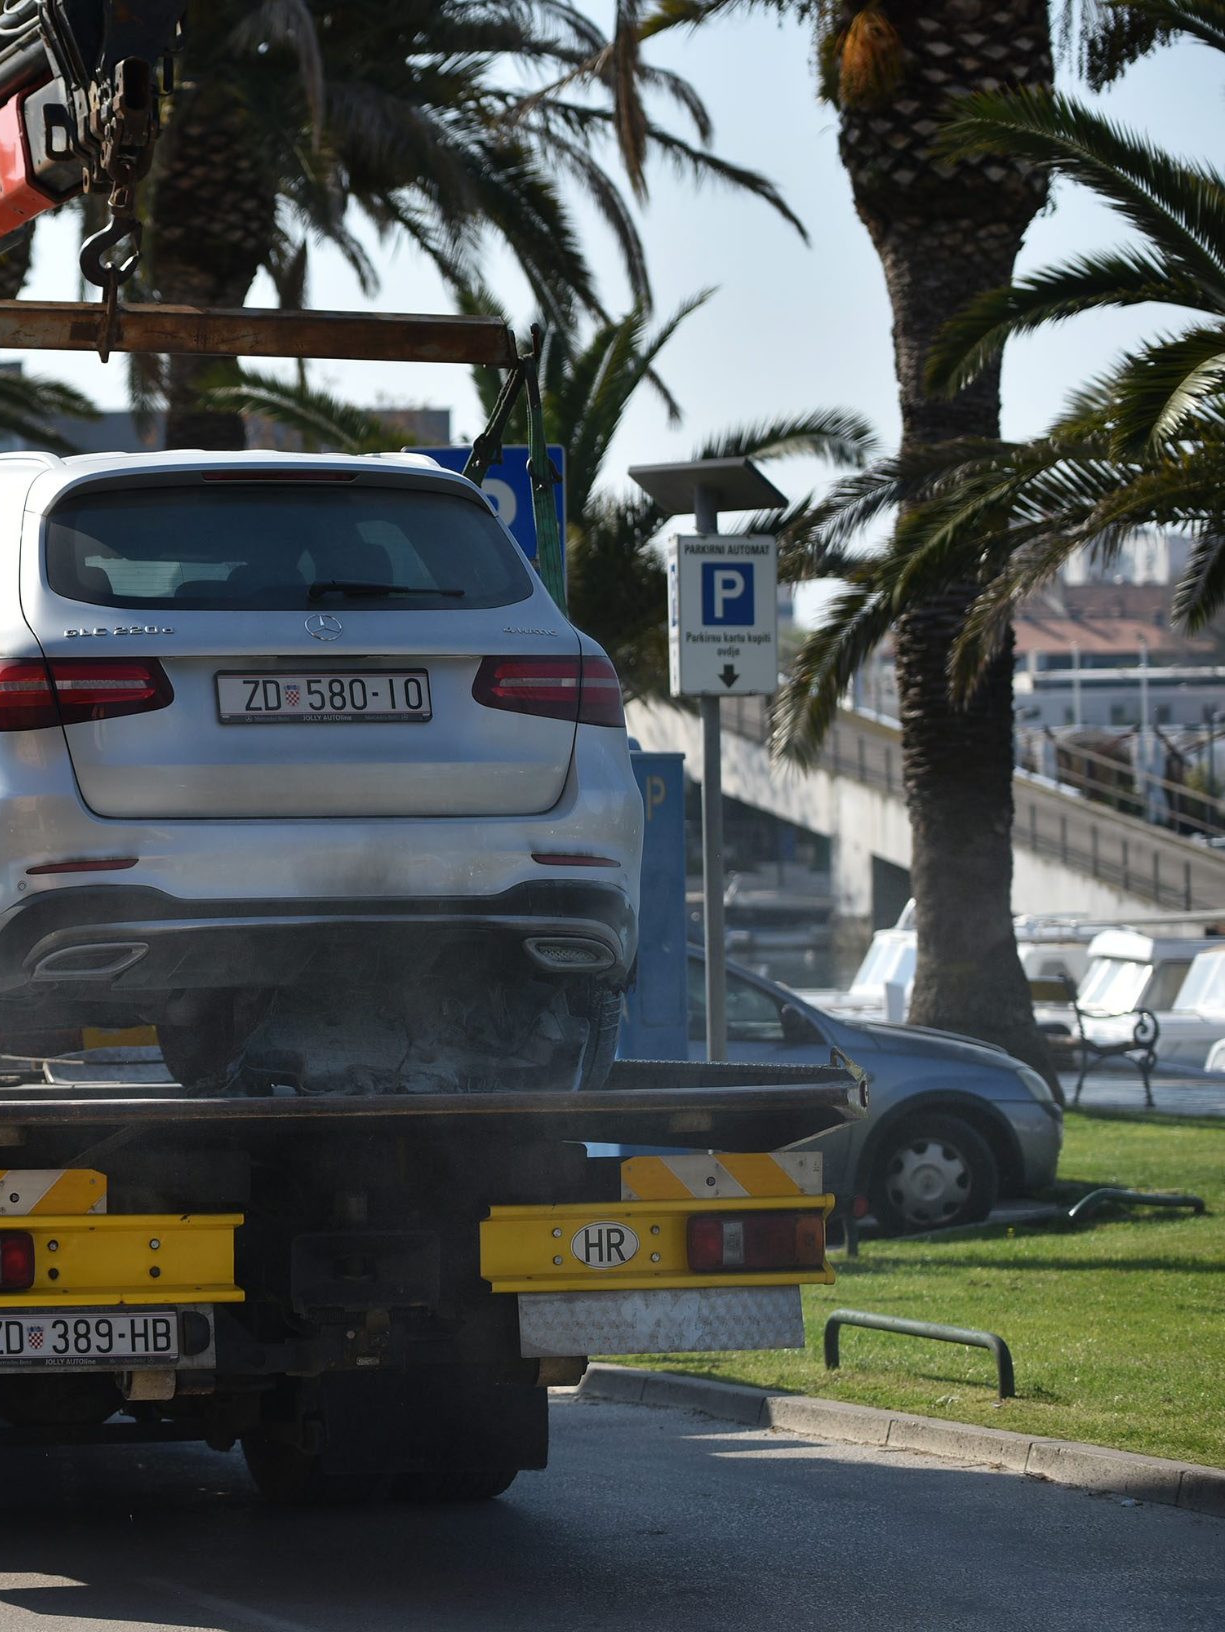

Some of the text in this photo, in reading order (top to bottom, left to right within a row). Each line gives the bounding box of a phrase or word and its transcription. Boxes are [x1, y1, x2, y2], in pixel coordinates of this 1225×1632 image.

[684, 544, 770, 555] PARKIRNI AUTOMAT
[714, 570, 745, 618] P
[63, 627, 108, 638] GLC
[686, 632, 721, 642] Parkirnu
[747, 632, 771, 645] kupiti
[717, 647, 740, 657] ovdje
[243, 680, 282, 711] ZD
[646, 776, 666, 821] P
[584, 1228, 626, 1263] HR
[51, 1318, 172, 1354] 389-HB
[45, 1358, 64, 1366] JOLLY
[66, 1358, 96, 1366] AUTOline
